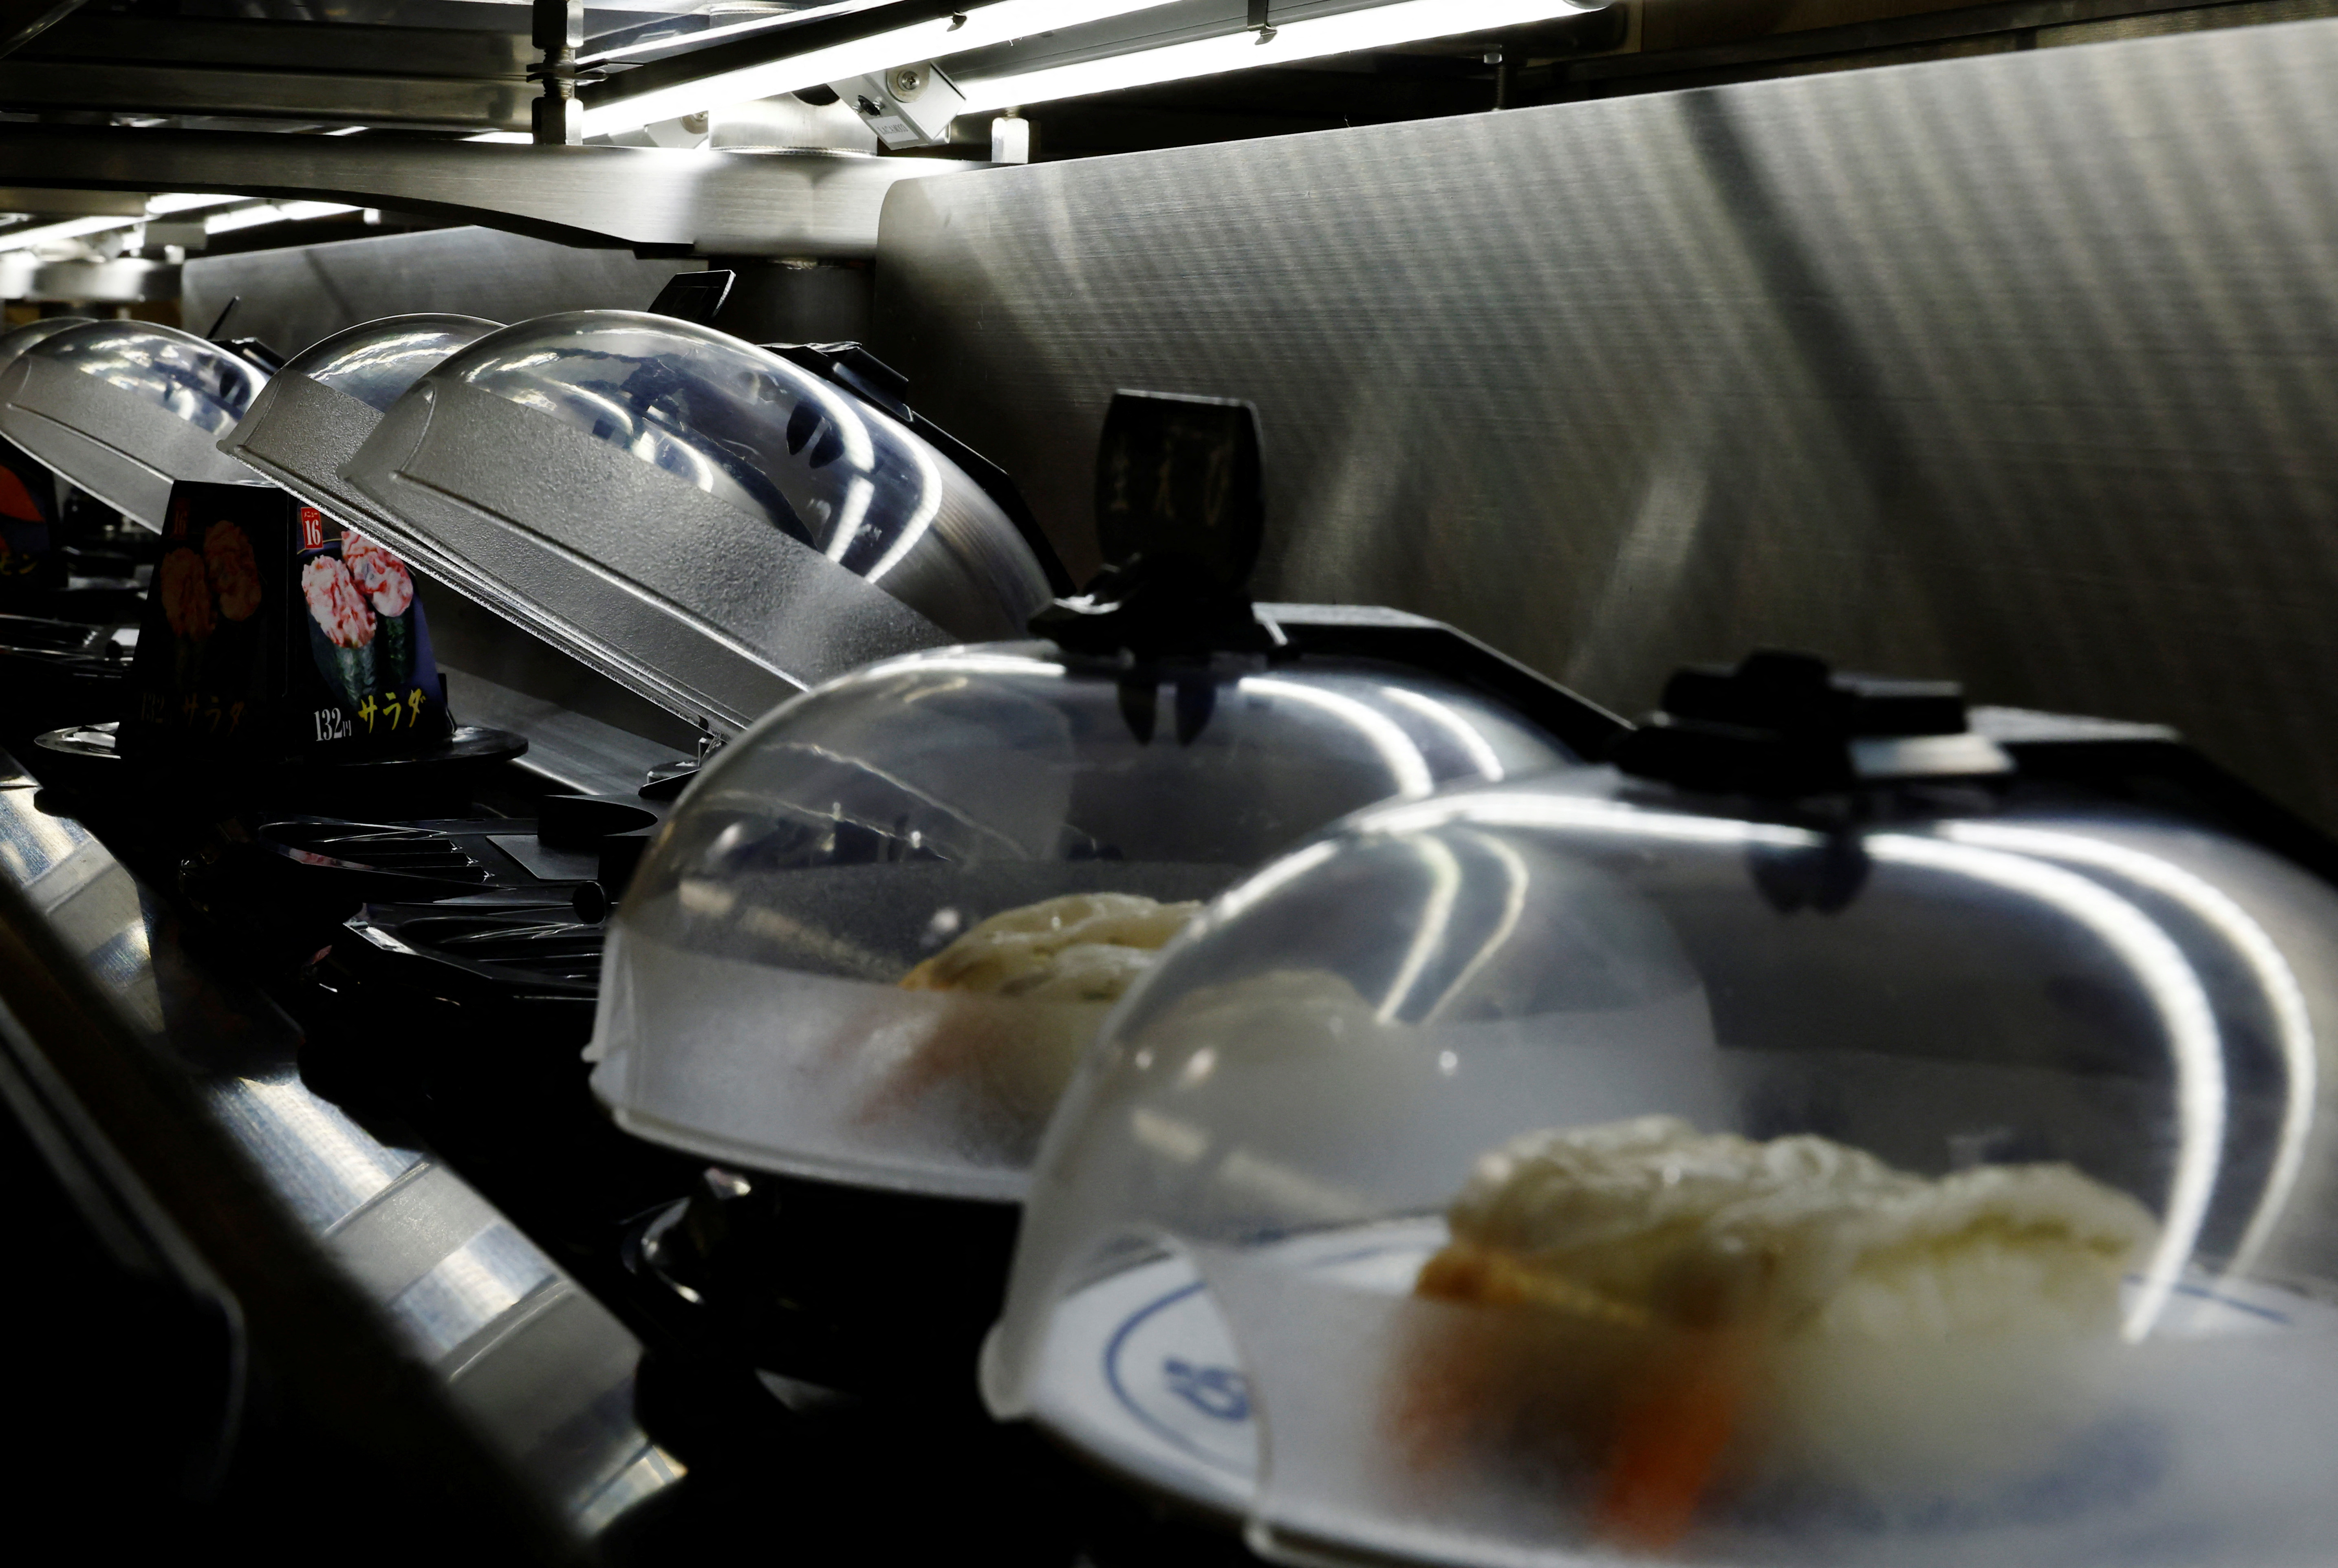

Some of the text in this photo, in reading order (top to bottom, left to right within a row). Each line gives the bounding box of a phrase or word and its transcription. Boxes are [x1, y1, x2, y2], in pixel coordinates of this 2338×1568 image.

[304, 519, 321, 545] 16
[181, 691, 248, 737] サラダ
[313, 688, 427, 741] 132円 サラダ
